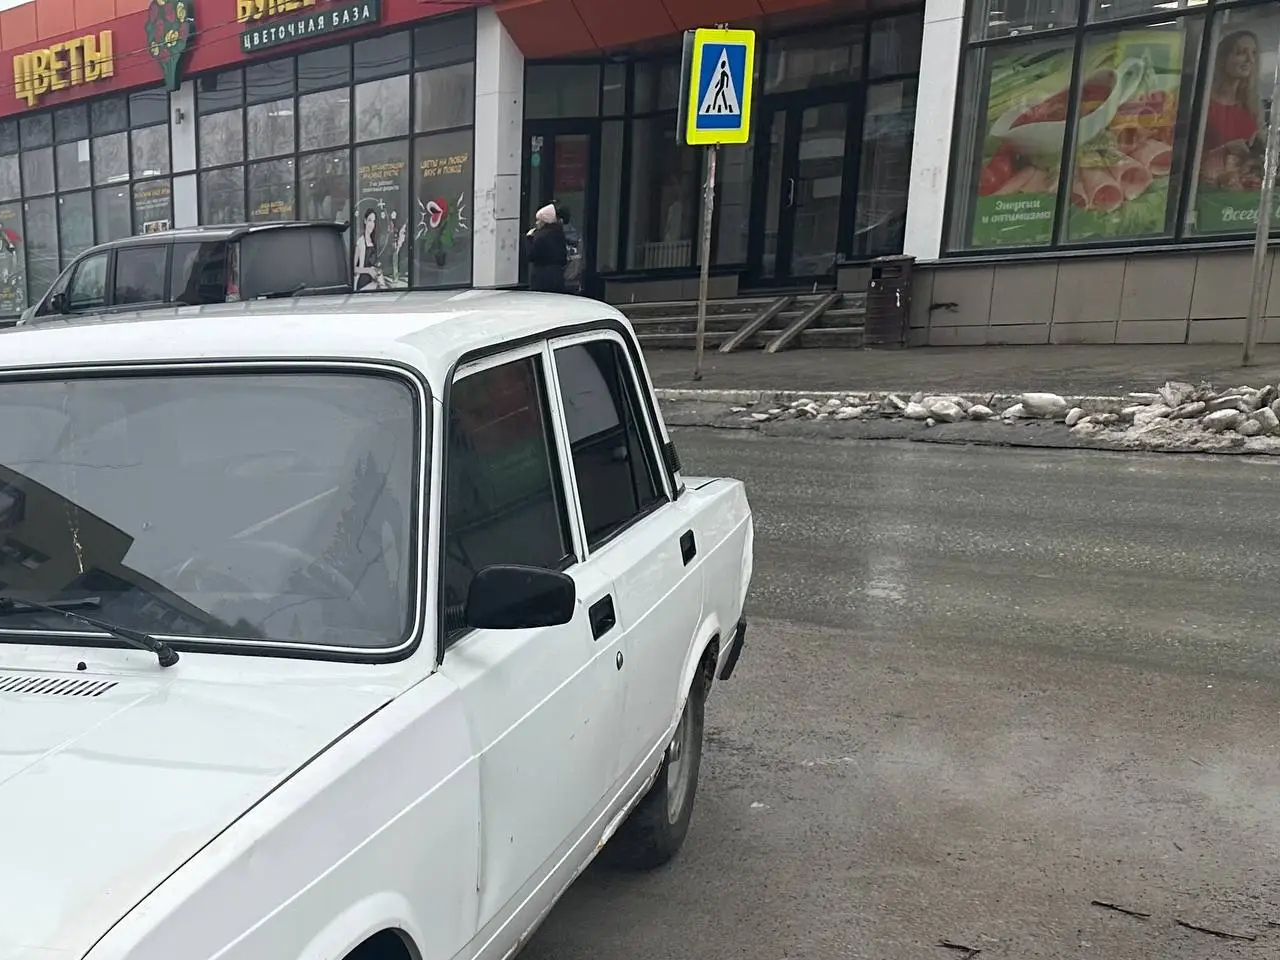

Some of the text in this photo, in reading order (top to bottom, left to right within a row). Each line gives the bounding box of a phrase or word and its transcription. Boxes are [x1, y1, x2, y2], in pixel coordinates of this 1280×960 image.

[243, 16, 324, 49] ЦВЕТОЧНАЯ
[332, 5, 370, 26] БАЗА
[13, 30, 114, 108] ЦВЕТЫ
